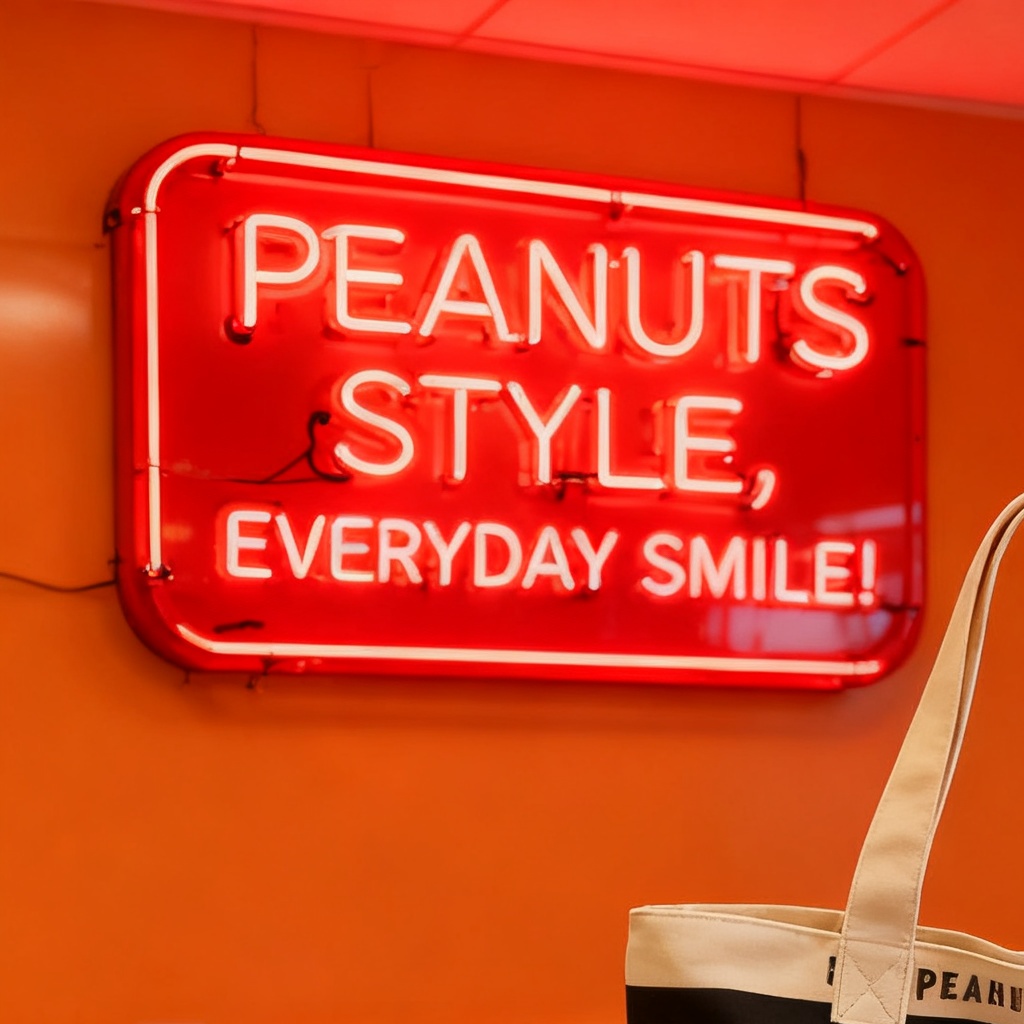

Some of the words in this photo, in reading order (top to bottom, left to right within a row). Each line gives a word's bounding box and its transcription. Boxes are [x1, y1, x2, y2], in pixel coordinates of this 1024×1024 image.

[240, 213, 871, 373] PEANUTS
[334, 368, 776, 511] STYLE,
[225, 510, 617, 591] EVERYDAY
[641, 533, 877, 607] SMILE!
